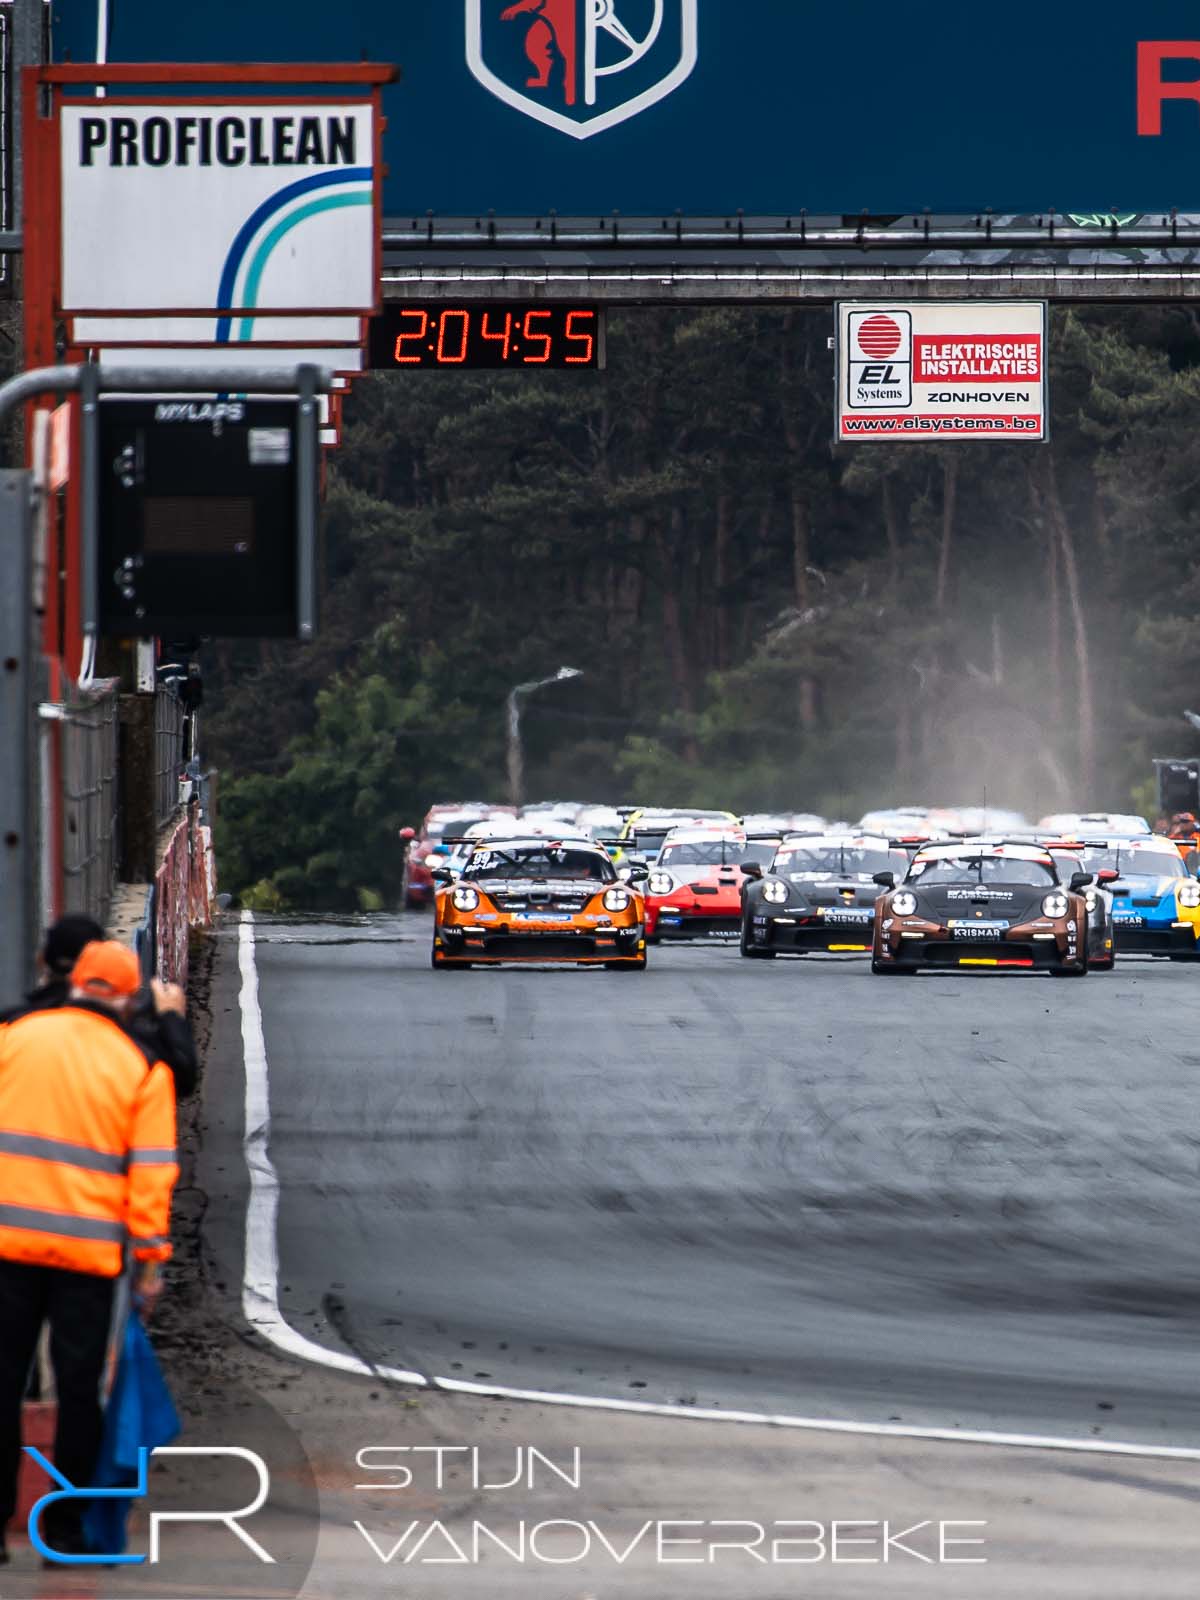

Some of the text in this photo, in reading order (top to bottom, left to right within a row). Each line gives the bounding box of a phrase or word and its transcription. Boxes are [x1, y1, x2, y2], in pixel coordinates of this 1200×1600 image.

[79, 116, 357, 167] PROFICLEAN
[920, 343, 1038, 359] ELEKTRISCHE
[858, 365, 901, 385] EL
[920, 360, 1038, 376] INSTALLATIES
[856, 386, 902, 403] Systems
[927, 392, 1030, 403] ZONHOVEN
[845, 417, 1036, 433] www.elsystems.be
[824, 915, 869, 924] KRISMAR
[954, 928, 1000, 937] KRISMAR
